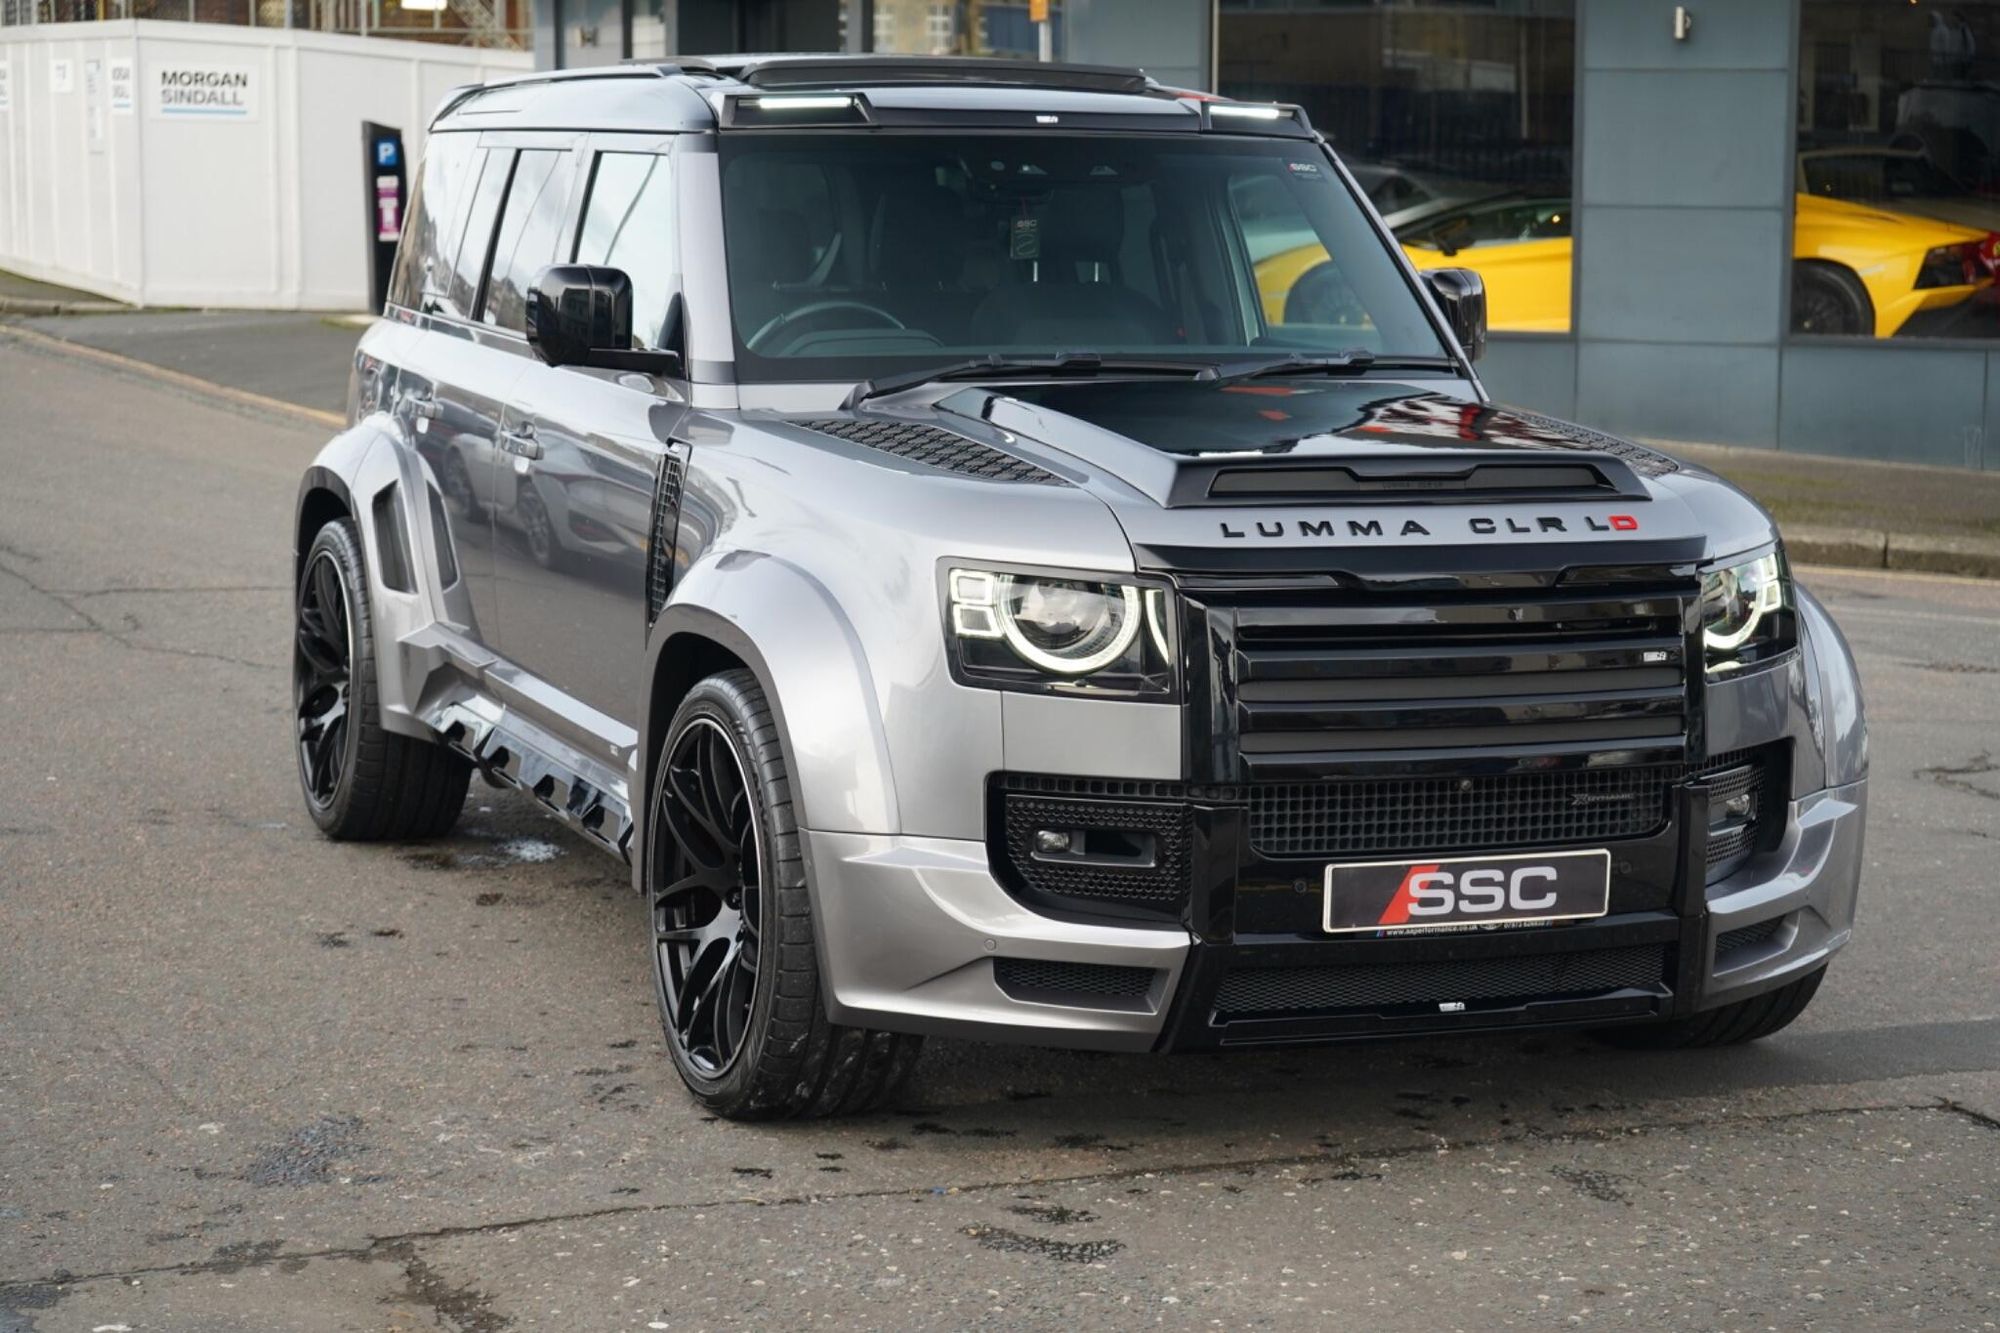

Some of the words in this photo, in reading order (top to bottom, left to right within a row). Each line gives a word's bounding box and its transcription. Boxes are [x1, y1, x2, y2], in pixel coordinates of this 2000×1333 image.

[161, 71, 248, 88] MORGAN
[161, 88, 244, 105] SINDALL
[377, 141, 396, 166] P
[1219, 519, 1431, 538] LUMMA
[1468, 516, 1568, 535] CLR
[1407, 865, 1558, 916] SSC
